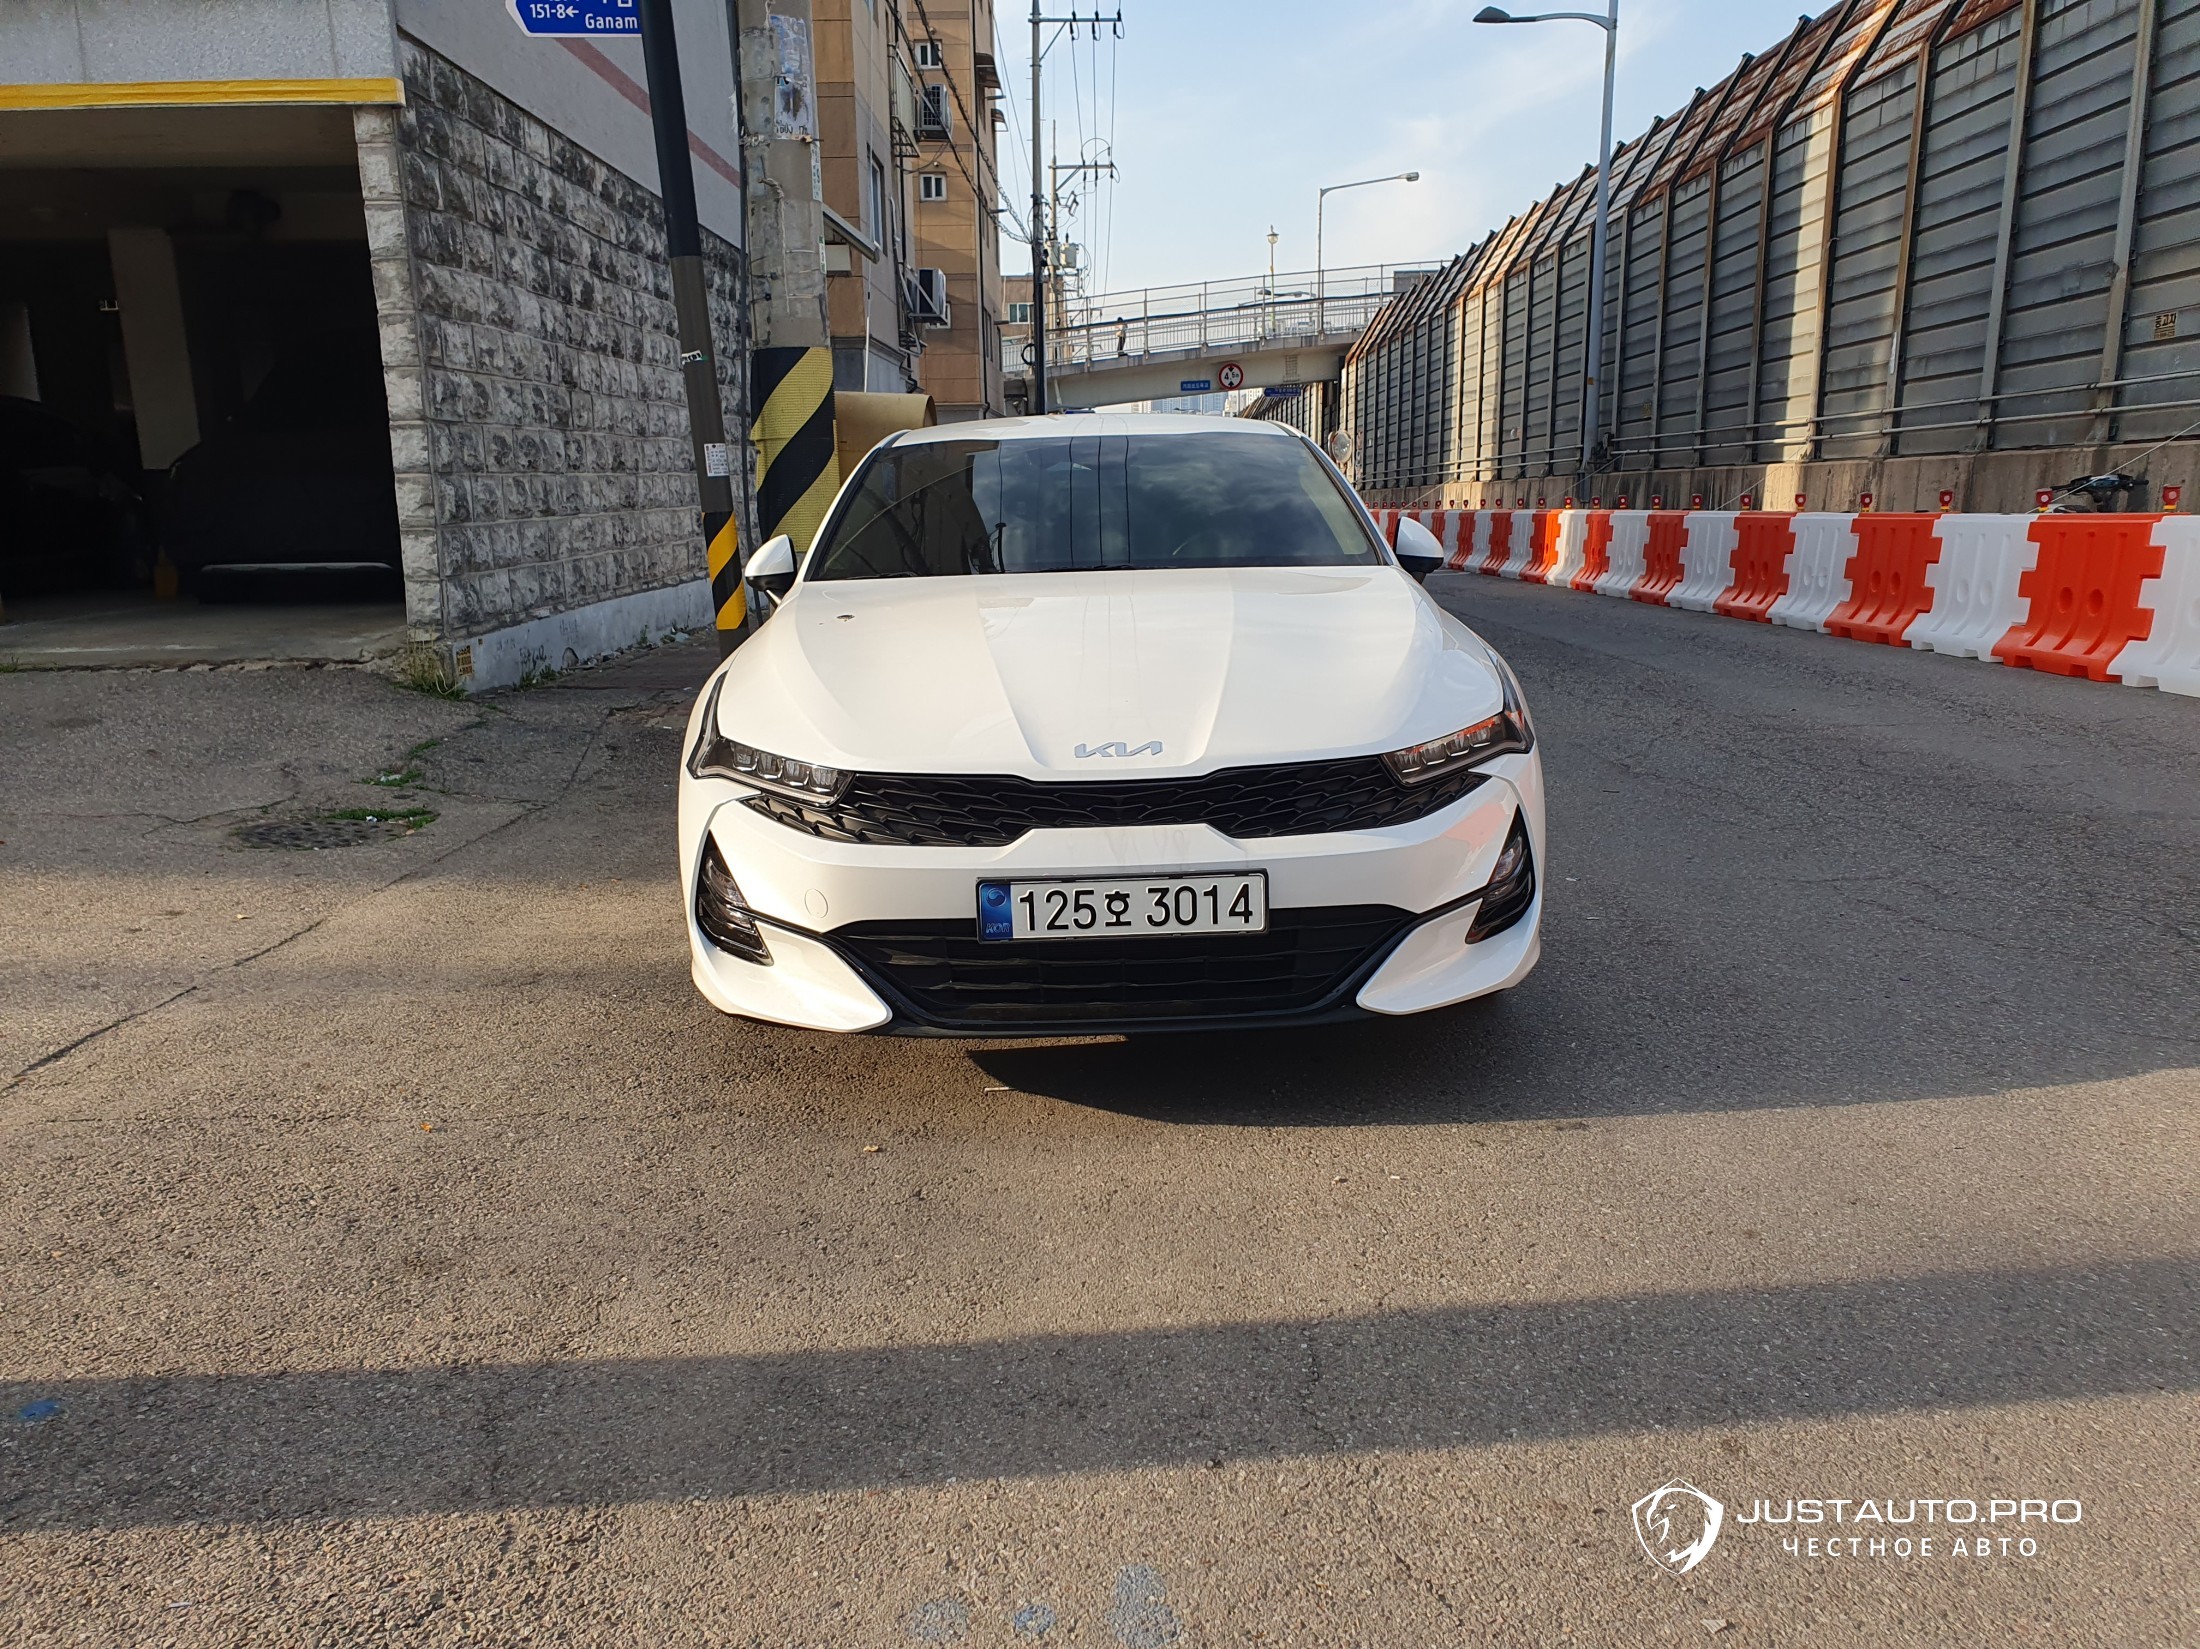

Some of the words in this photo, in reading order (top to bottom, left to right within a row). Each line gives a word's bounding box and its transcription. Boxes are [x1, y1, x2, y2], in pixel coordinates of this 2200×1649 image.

[530, 4, 566, 19] 151-8
[585, 13, 638, 29] Ganam
[1074, 740, 1163, 758] KIA
[1018, 889, 1132, 932] 125호
[1145, 882, 1253, 927] 3014
[985, 922, 1010, 934] KOR
